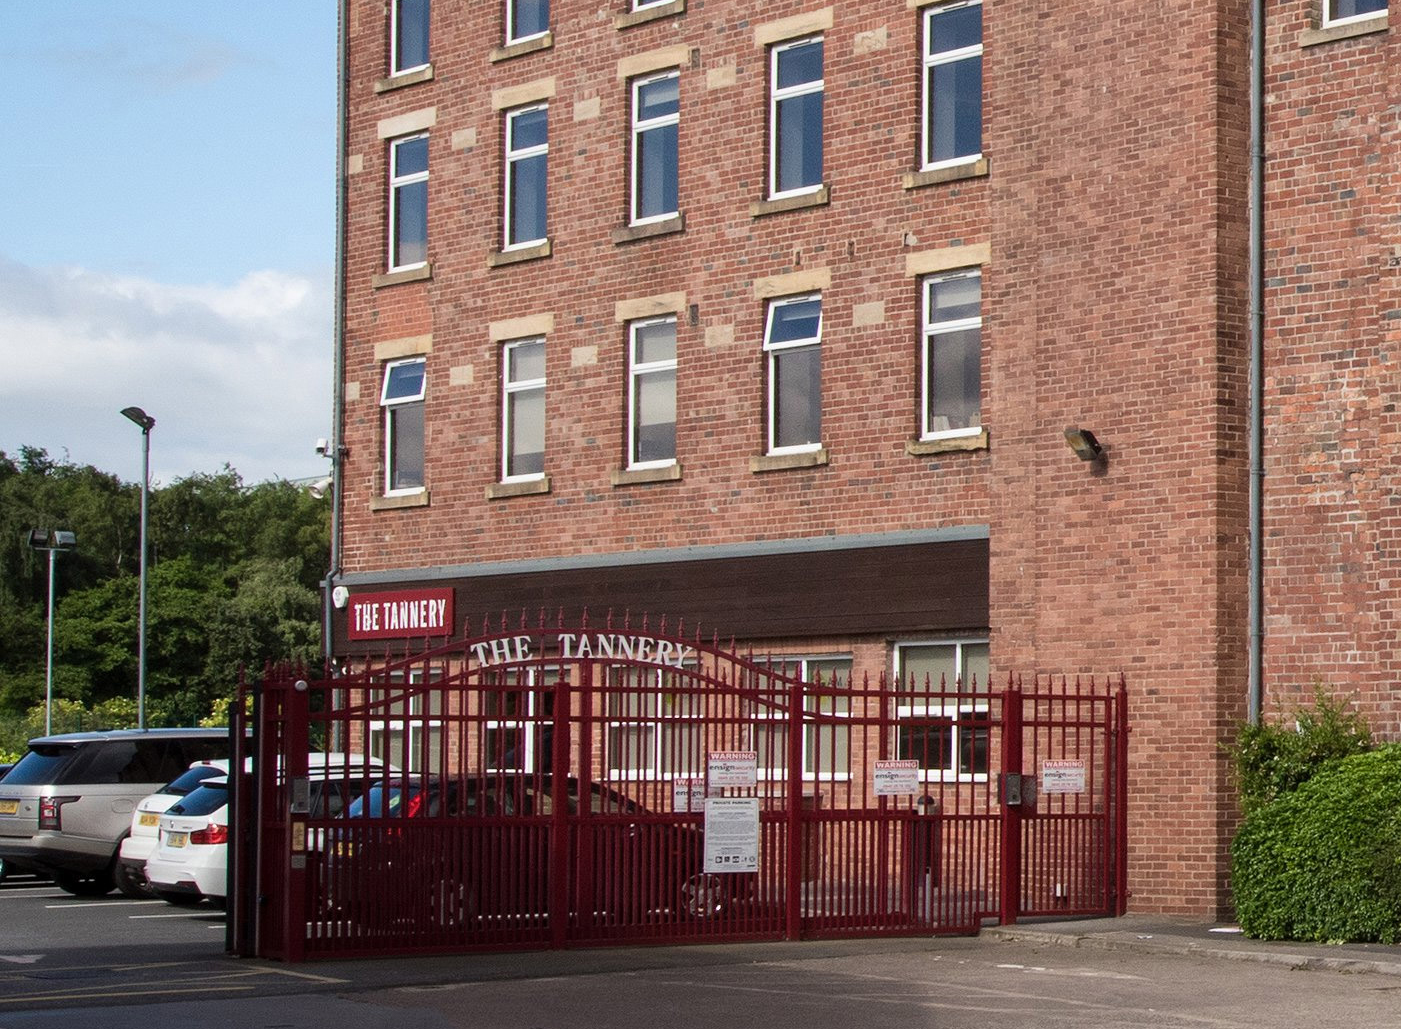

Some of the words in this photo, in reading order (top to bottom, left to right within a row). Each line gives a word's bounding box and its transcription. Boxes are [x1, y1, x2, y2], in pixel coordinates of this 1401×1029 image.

[354, 602, 379, 632] THE
[383, 599, 446, 630] TANNERY
[470, 635, 534, 668] THE
[557, 633, 693, 670] TANNERY
[710, 752, 755, 760] WARNING
[876, 761, 917, 769] WARNING
